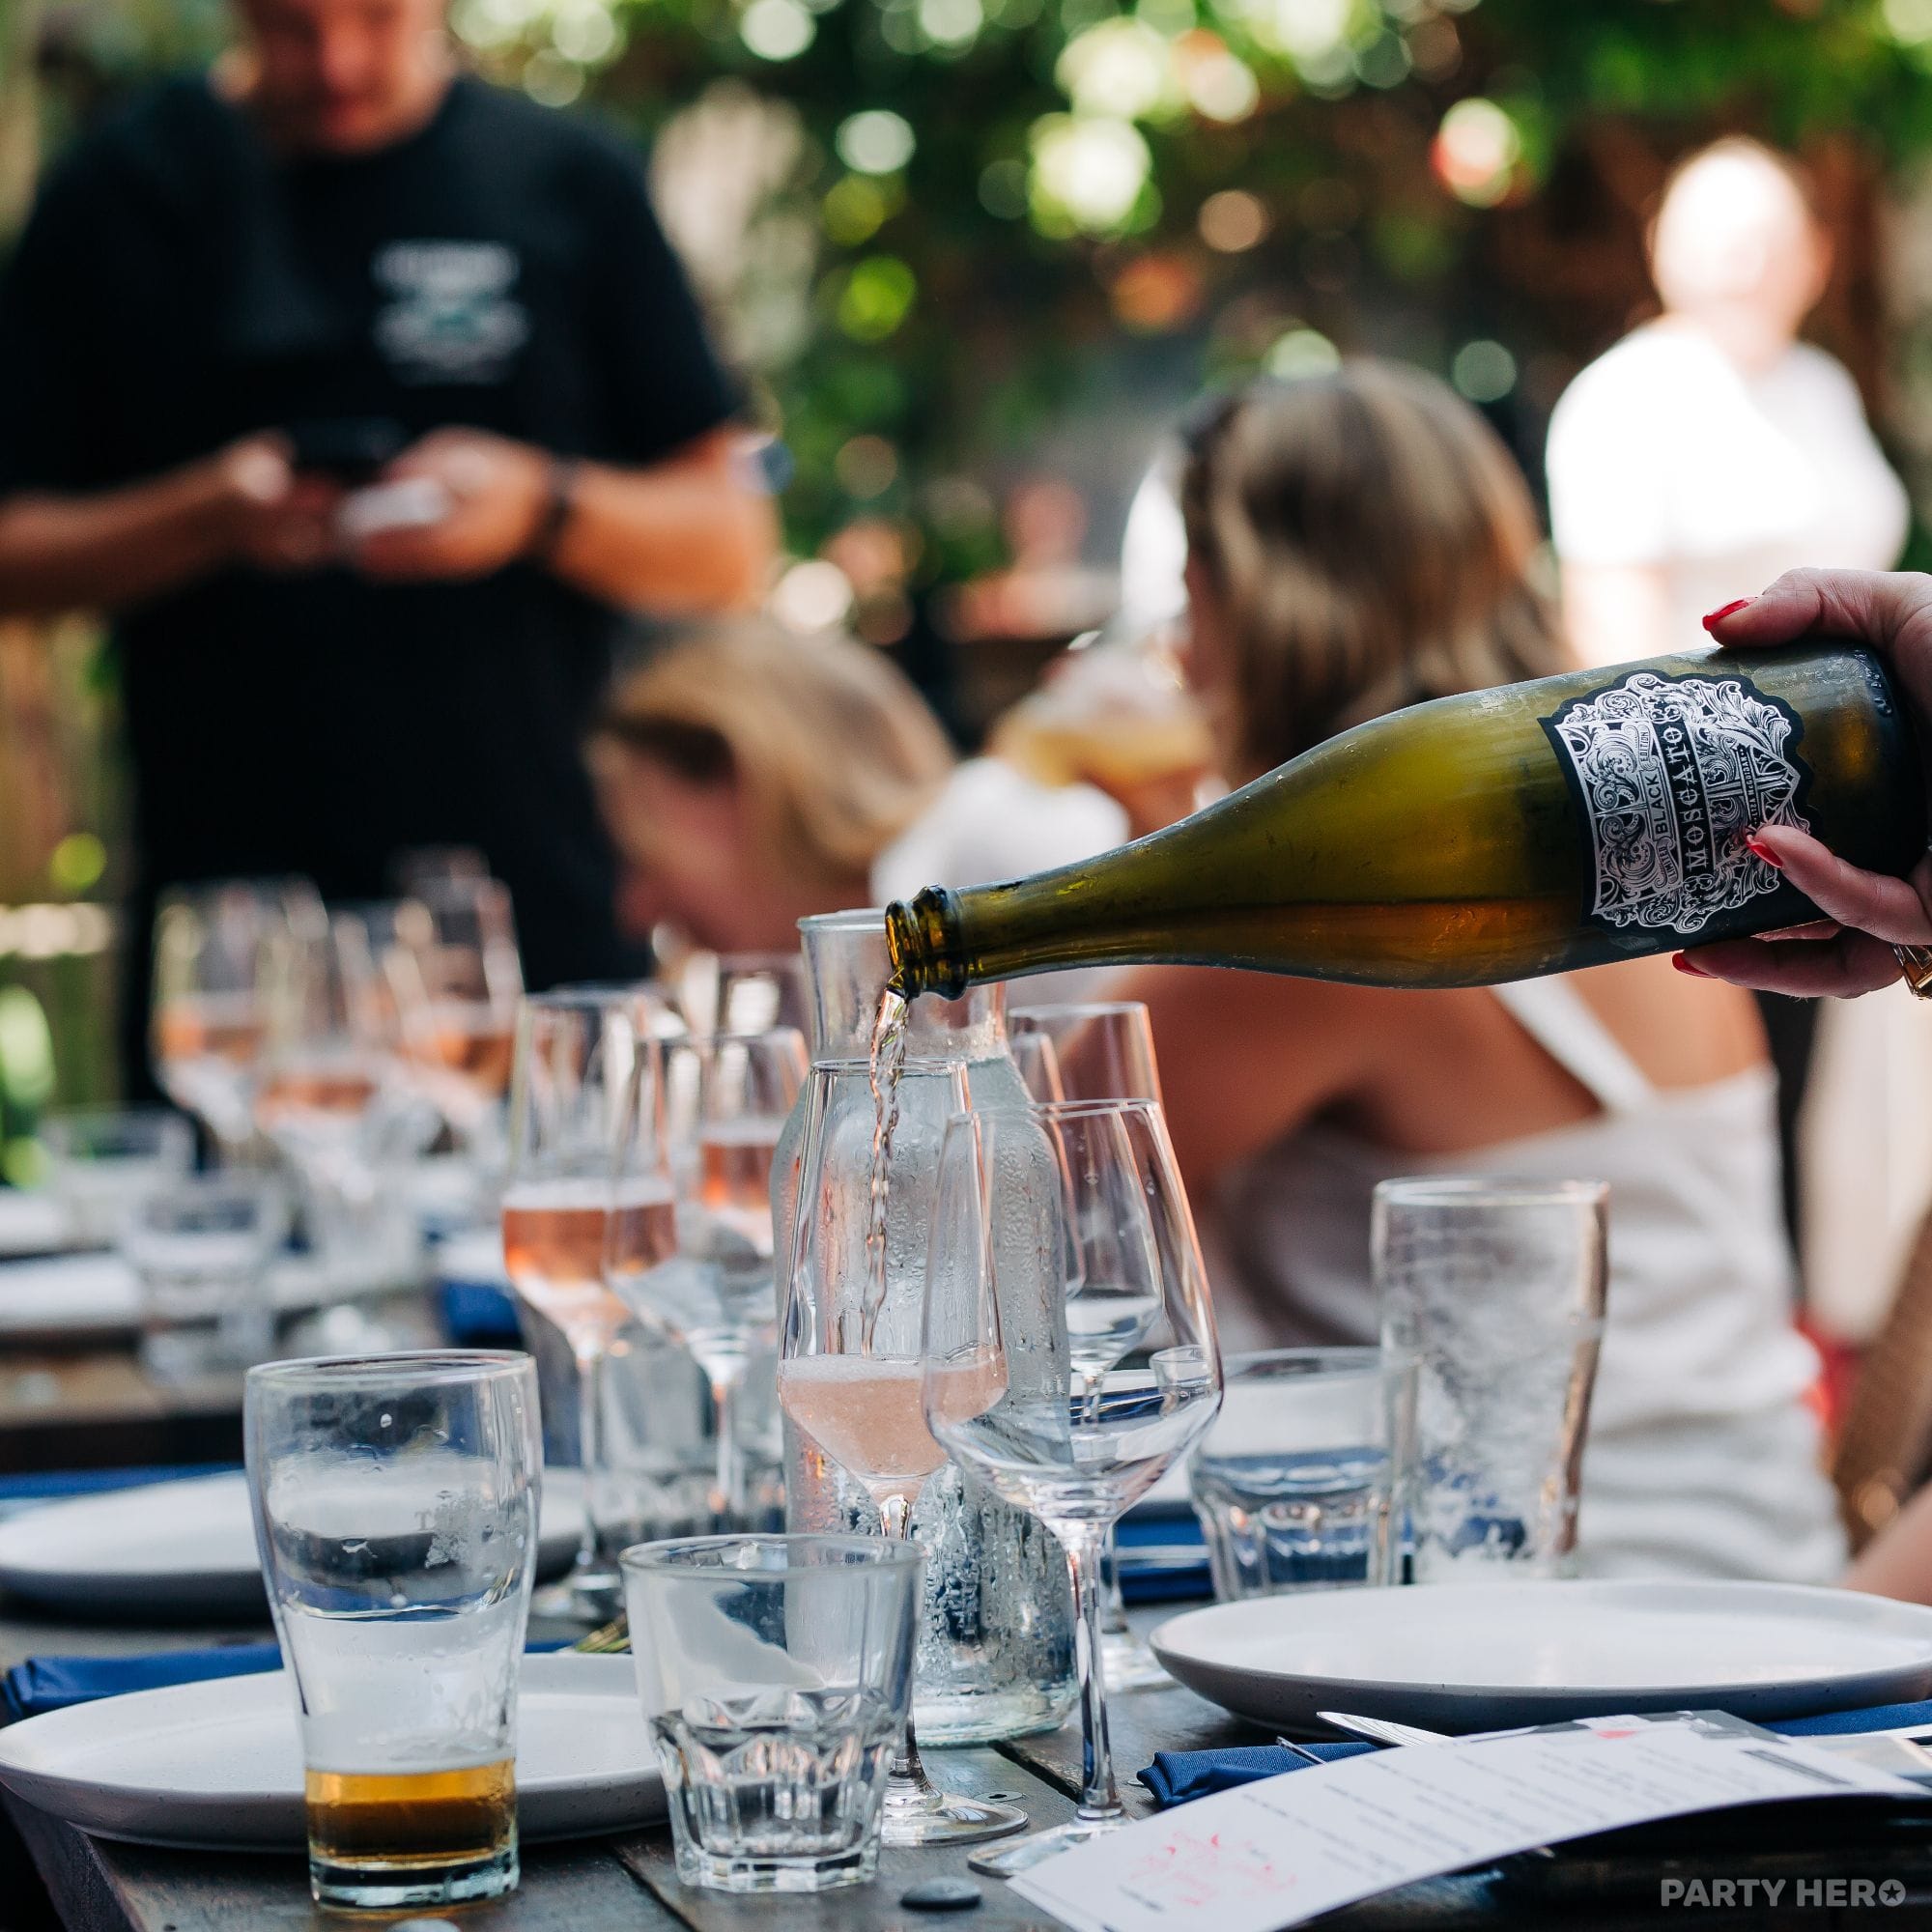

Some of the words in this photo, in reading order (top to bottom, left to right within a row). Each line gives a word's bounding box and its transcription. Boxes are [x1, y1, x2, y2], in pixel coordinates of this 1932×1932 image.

[1639, 731, 1649, 762] EDITION
[1644, 774, 1669, 835] BLACK
[1661, 725, 1710, 872] MOSCATO
[1659, 846, 1676, 877] LIMITED
